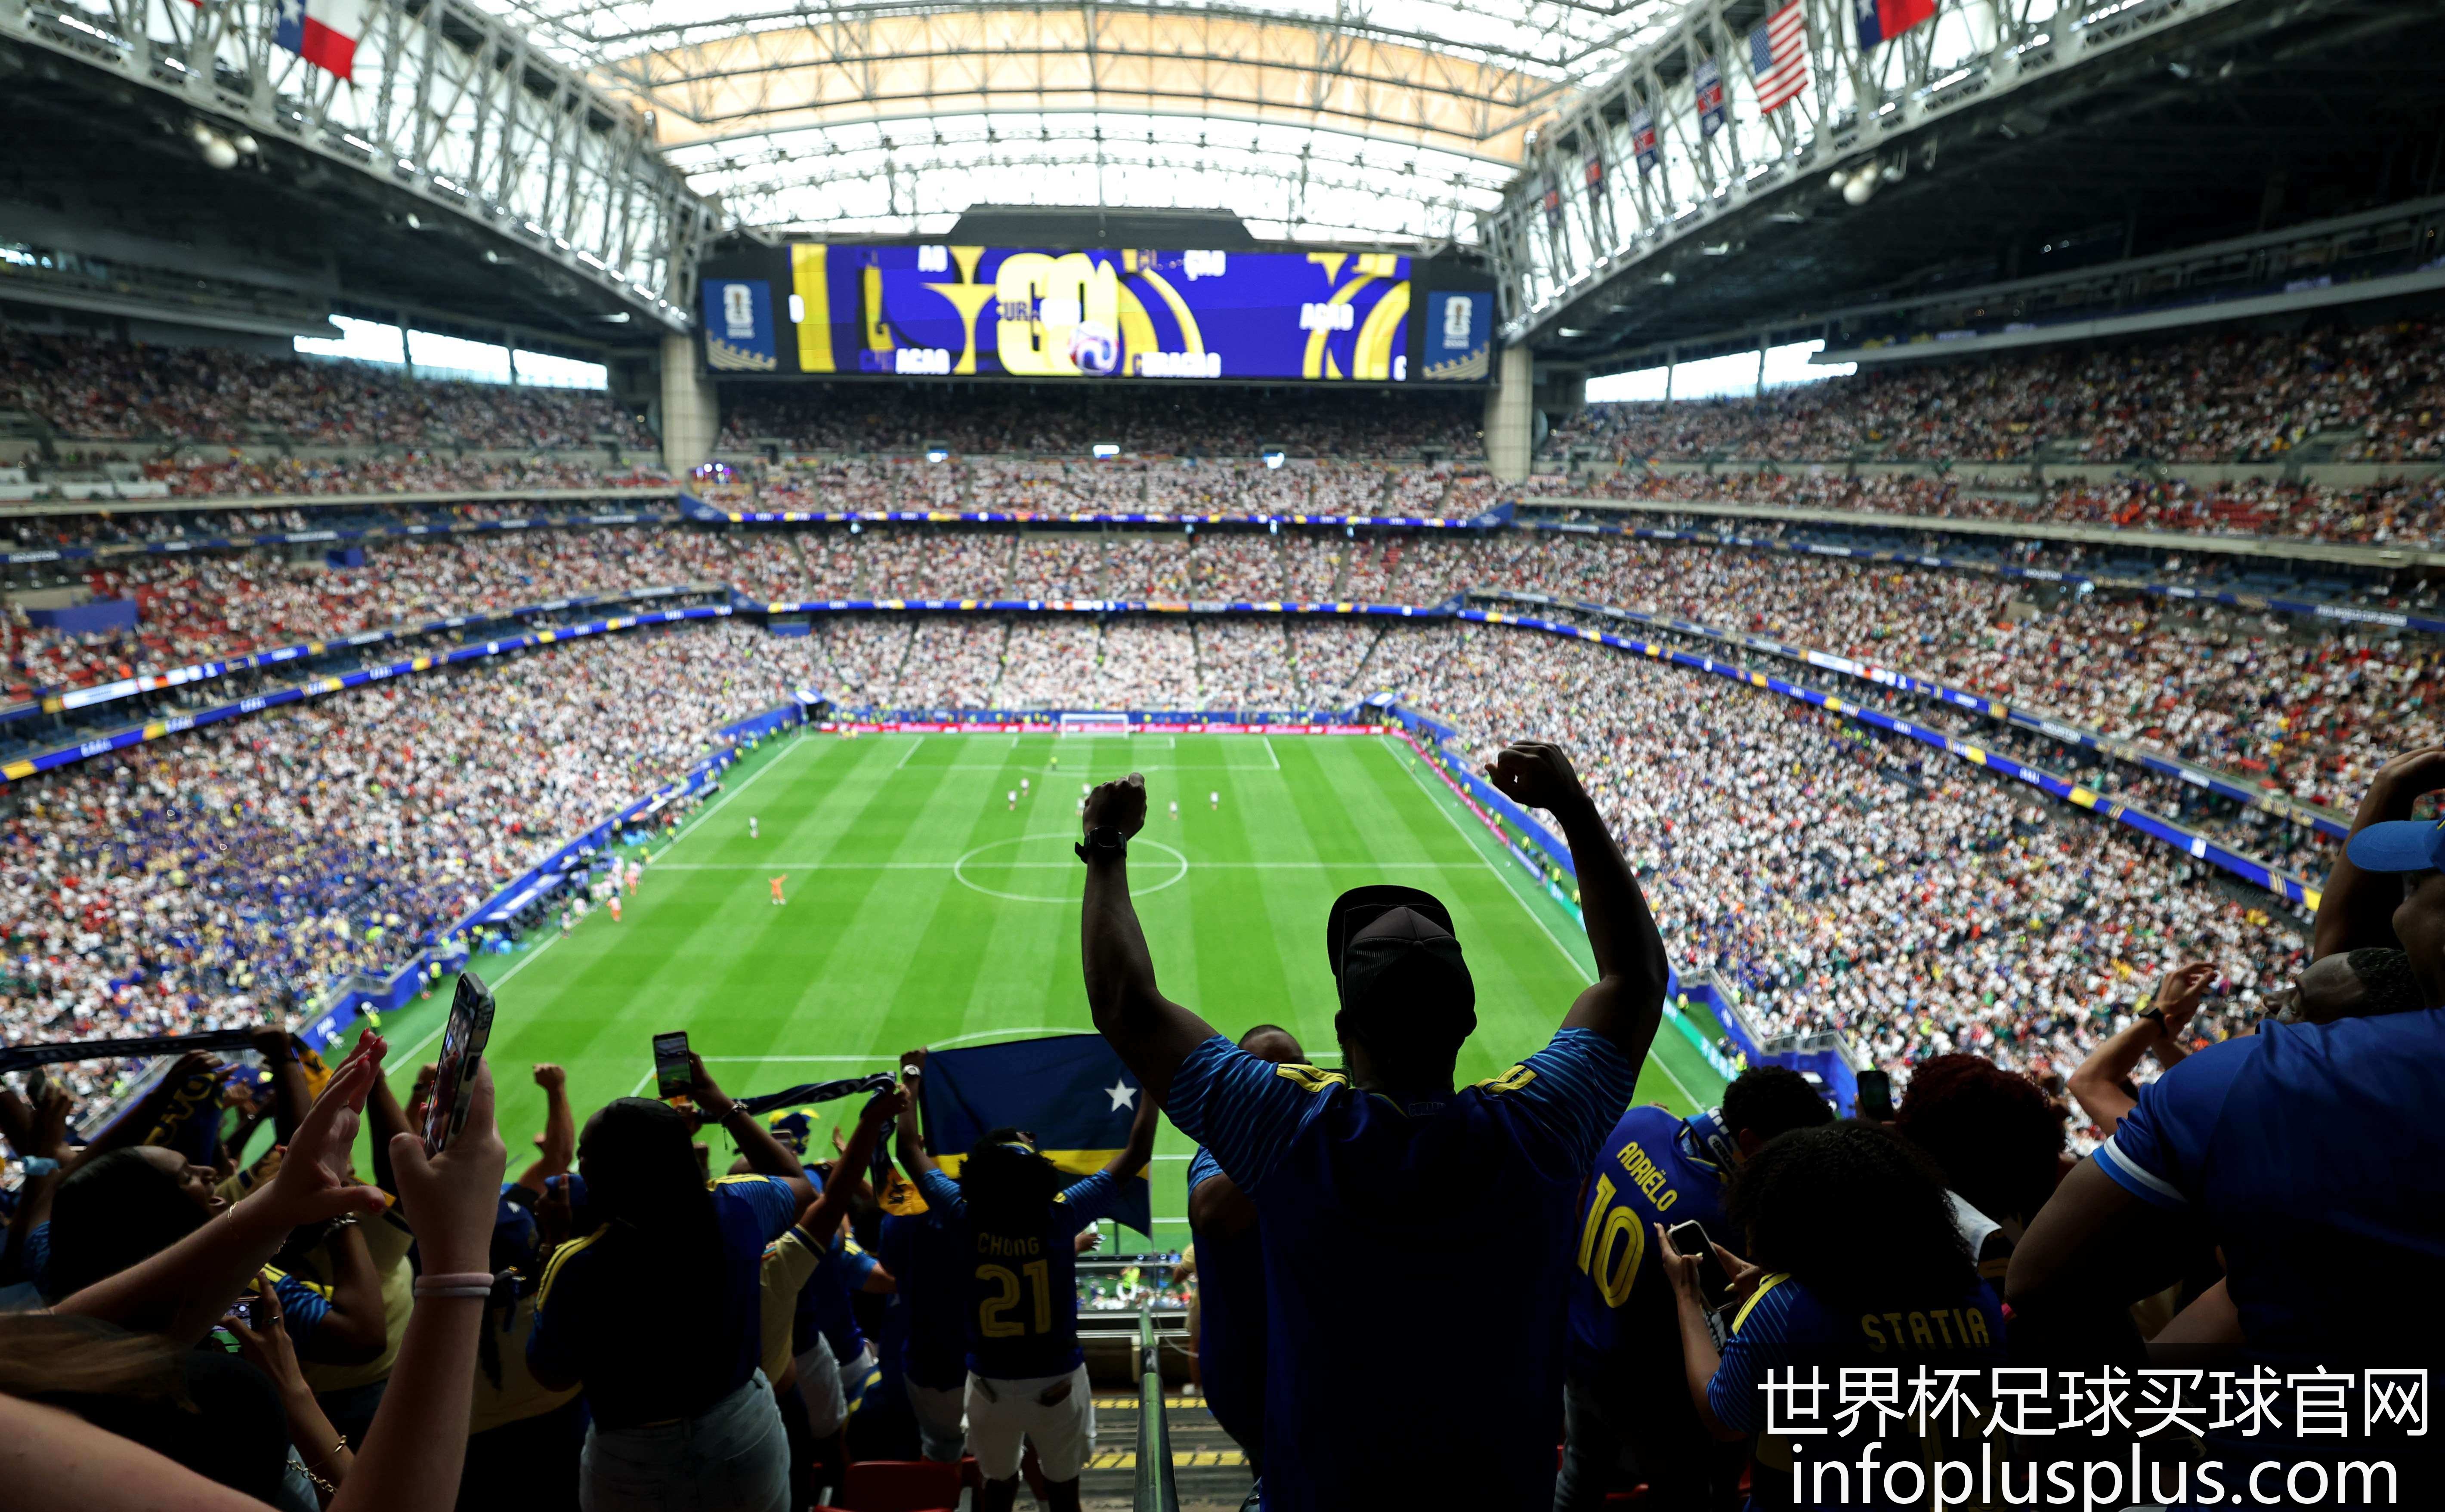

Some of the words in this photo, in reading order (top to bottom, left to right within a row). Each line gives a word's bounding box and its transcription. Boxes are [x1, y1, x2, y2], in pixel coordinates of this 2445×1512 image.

[1617, 1141, 1678, 1212] ADRIËLO
[977, 1232, 1040, 1256] CHONG
[1577, 1172, 1645, 1308] 10
[975, 1259, 1051, 1338] 21
[1861, 1307, 1990, 1353] STATIA
